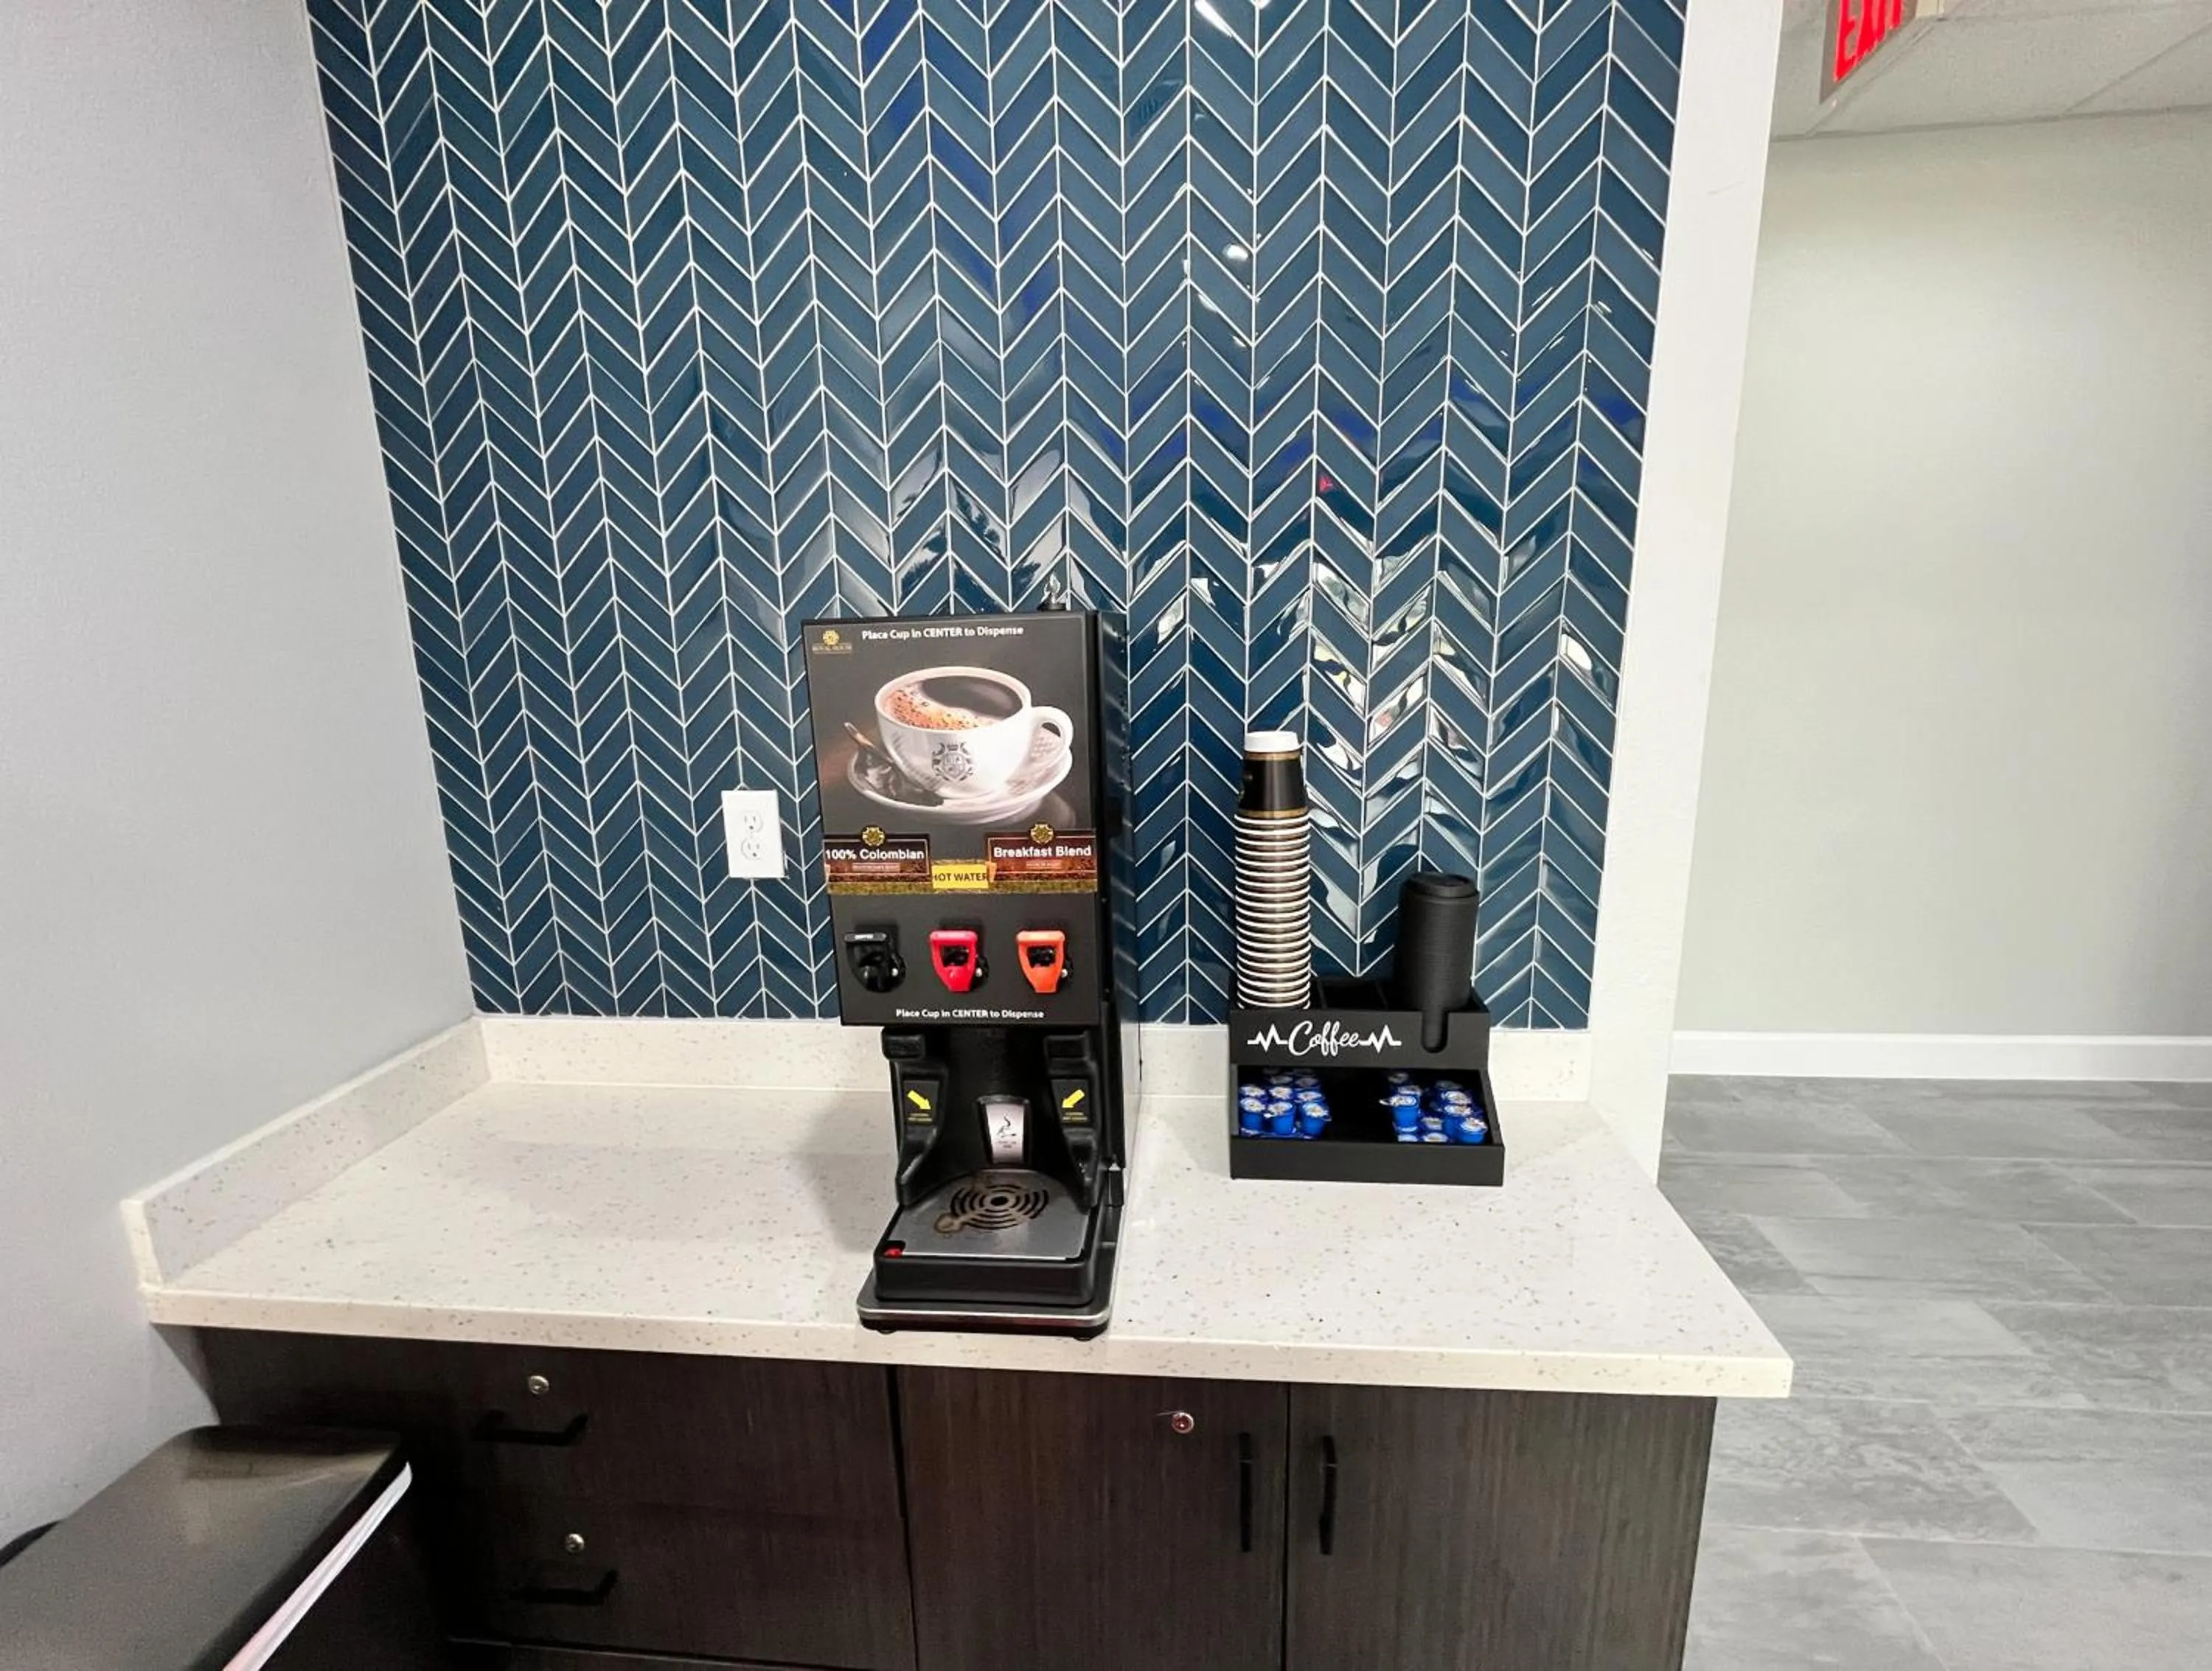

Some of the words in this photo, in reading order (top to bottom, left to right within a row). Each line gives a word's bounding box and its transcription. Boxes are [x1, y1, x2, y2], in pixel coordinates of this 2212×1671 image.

[862, 629, 888, 640] Place
[889, 629, 910, 641] Cup
[923, 626, 963, 638] CENTER
[964, 627, 975, 636] to
[977, 625, 1024, 638] Dispense
[825, 848, 858, 860] 100%
[859, 848, 925, 860] Colombian
[992, 846, 1053, 858] Breakfast
[1055, 844, 1092, 857] Blend
[895, 1008, 920, 1018] Place
[921, 1008, 940, 1019] Cup
[952, 1009, 988, 1018] CENTER
[990, 1010, 1001, 1018] to
[1001, 1009, 1045, 1020] Dispense
[1288, 1020, 1360, 1057] Coffee
